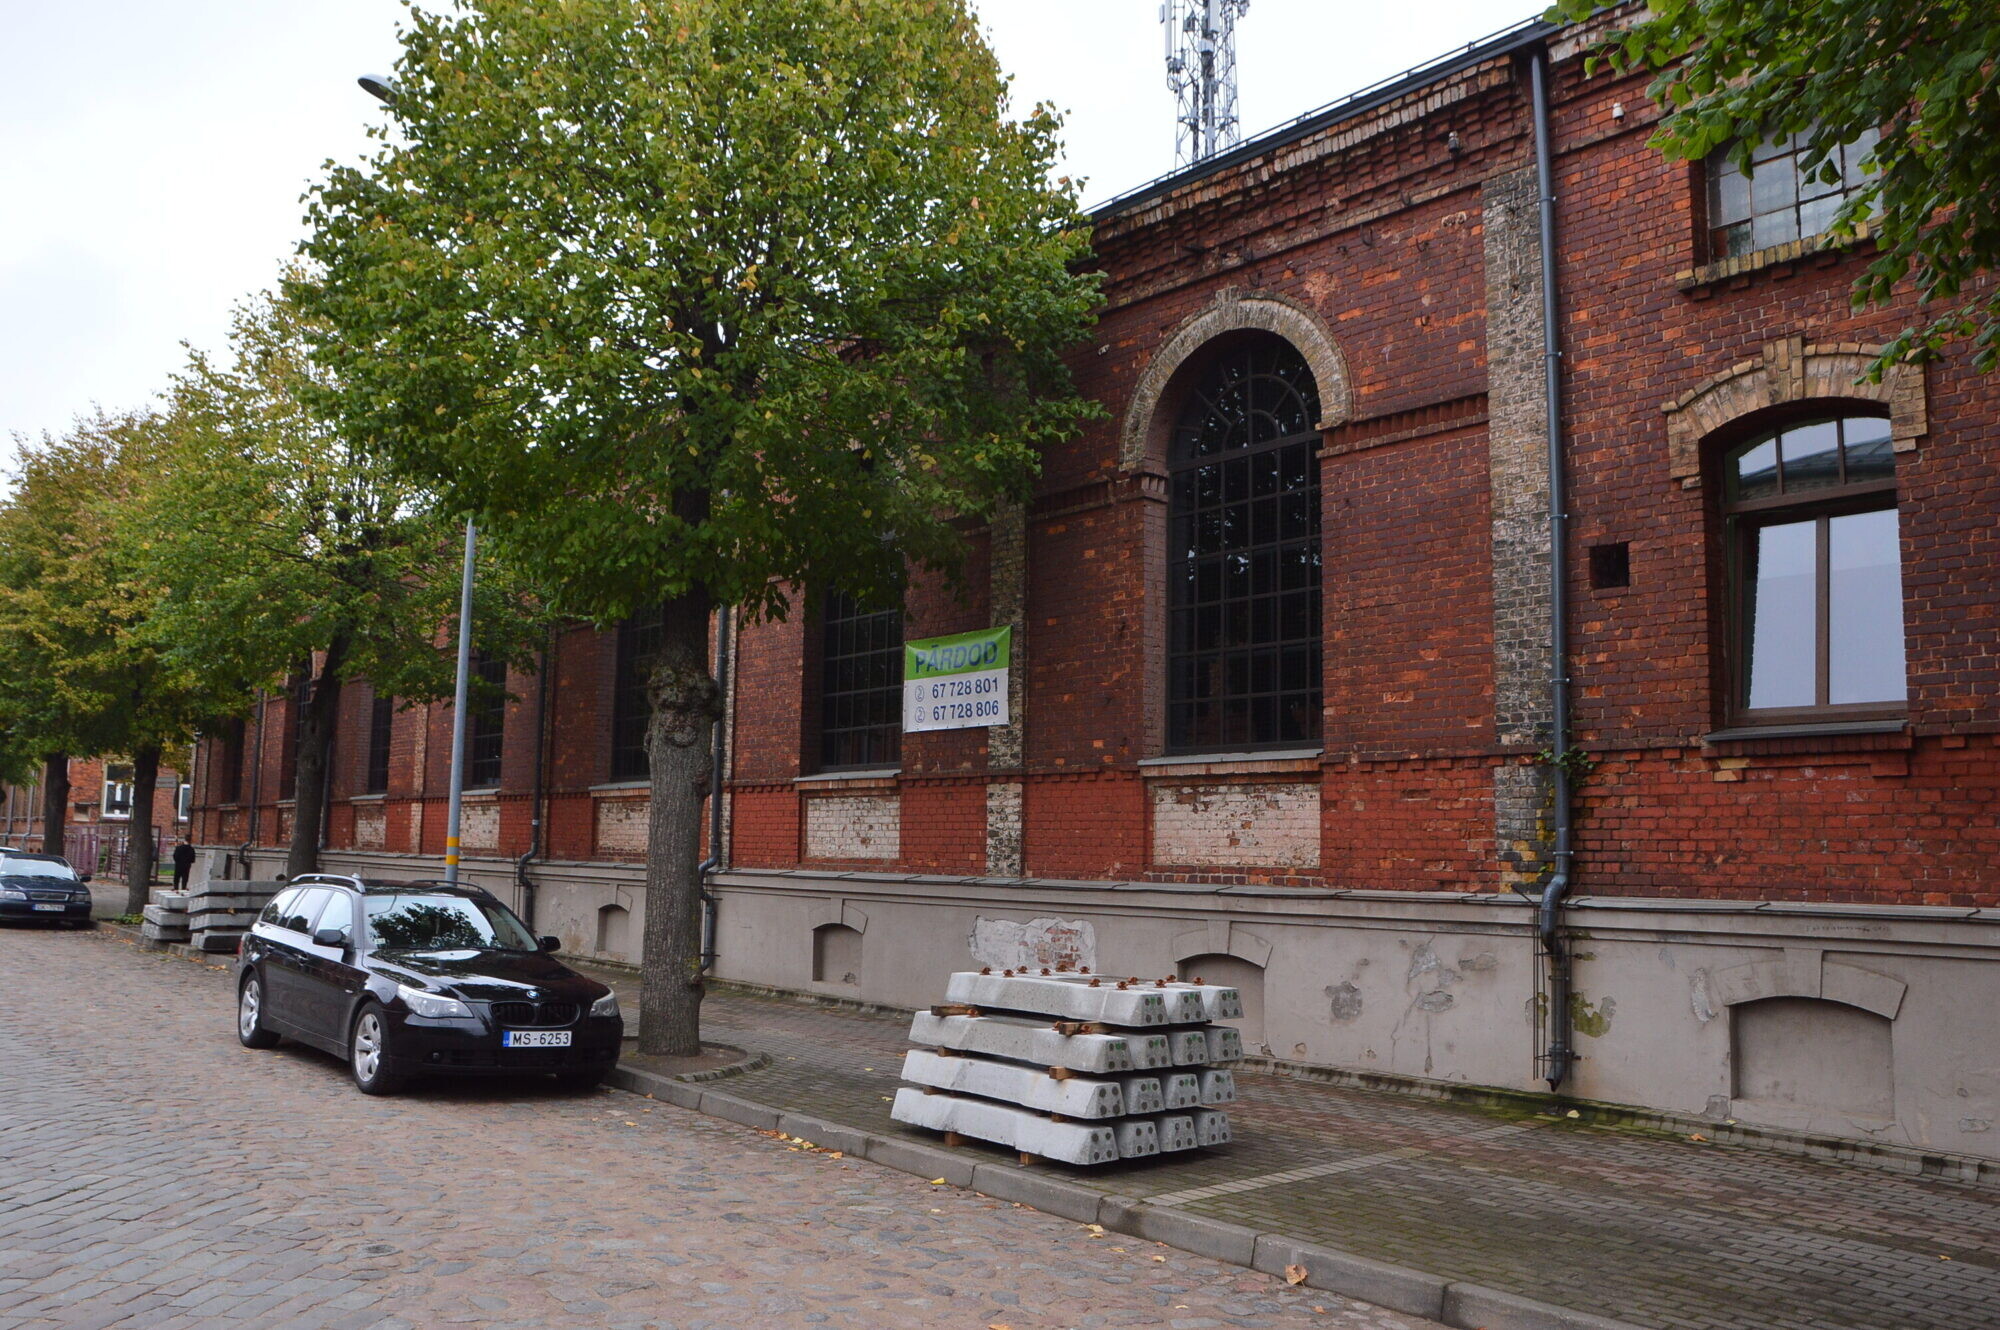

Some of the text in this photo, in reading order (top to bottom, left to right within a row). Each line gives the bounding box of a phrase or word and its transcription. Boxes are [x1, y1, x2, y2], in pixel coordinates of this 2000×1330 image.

[915, 641, 998, 673] PĀRDOD
[932, 677, 998, 699] 67 728 801
[933, 700, 999, 721] 67 728 806
